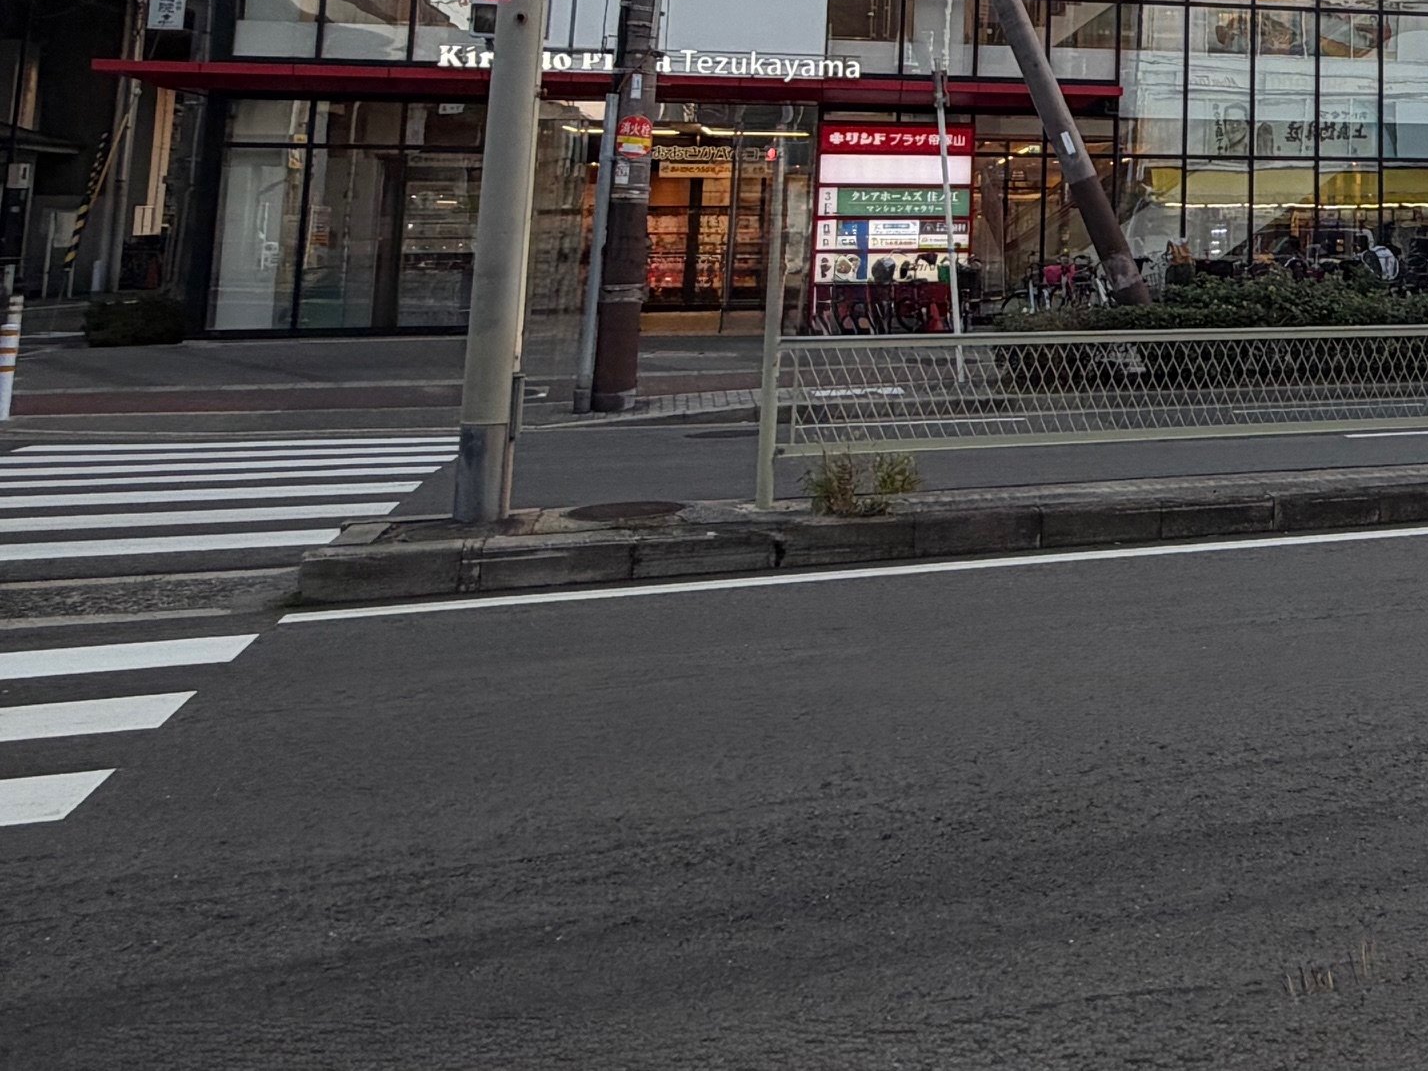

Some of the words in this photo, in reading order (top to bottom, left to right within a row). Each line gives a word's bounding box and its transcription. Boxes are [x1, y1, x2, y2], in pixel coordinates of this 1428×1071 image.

[581, 51, 672, 73] Pla
[680, 49, 860, 82] Tezukayama
[619, 121, 650, 138] 消火栓
[829, 132, 886, 145] キリンド
